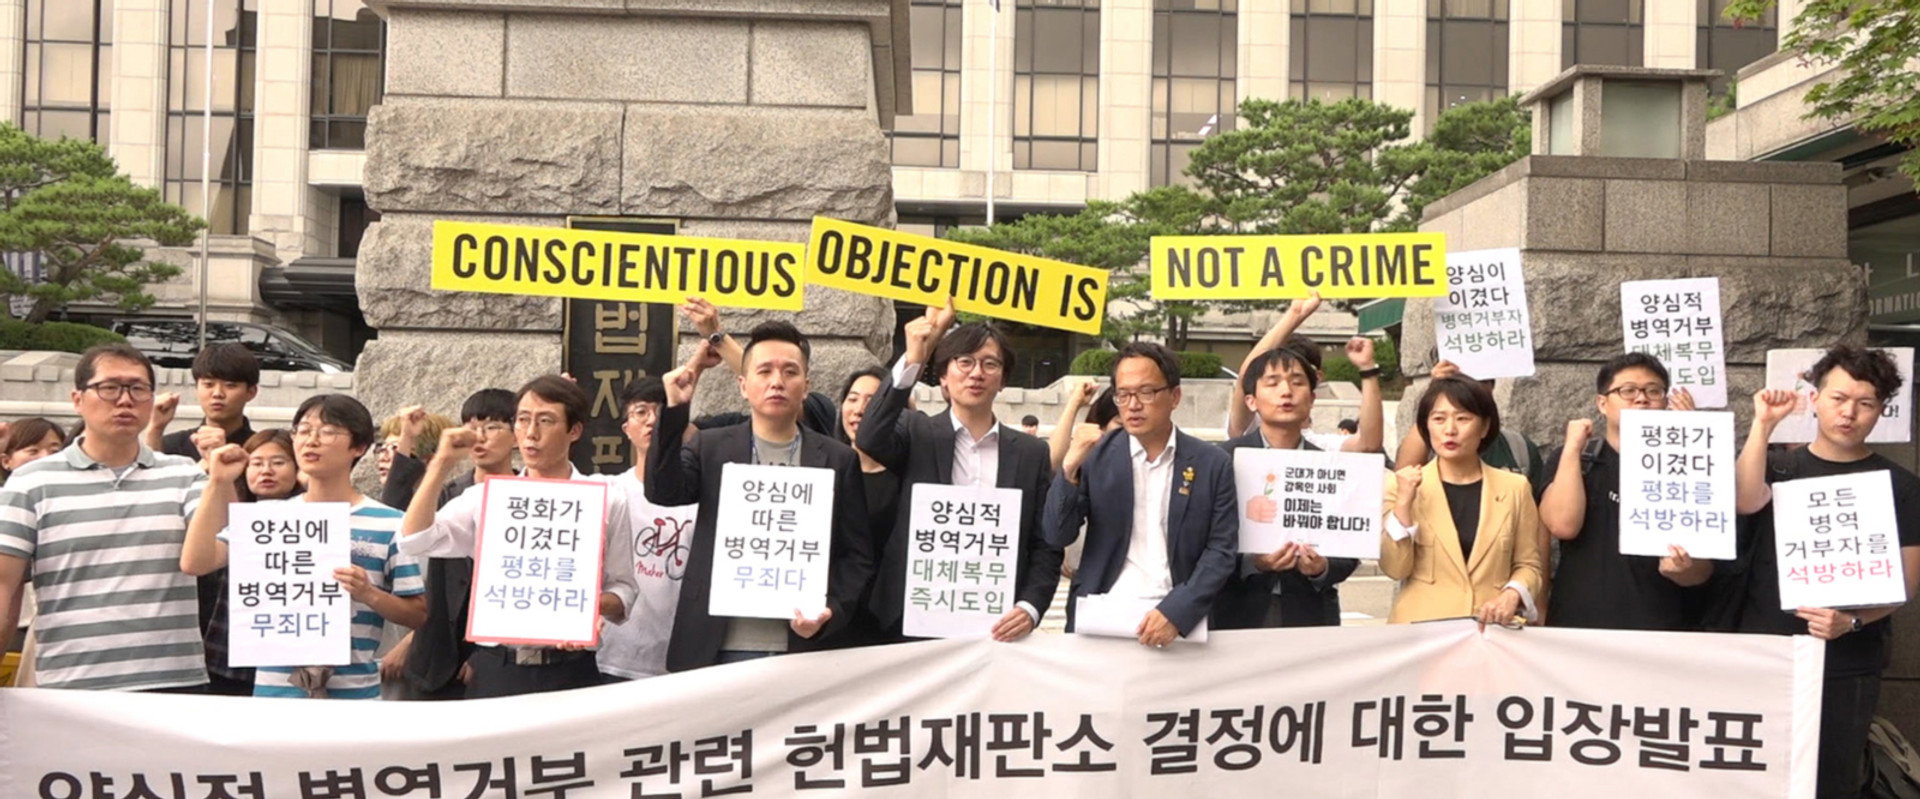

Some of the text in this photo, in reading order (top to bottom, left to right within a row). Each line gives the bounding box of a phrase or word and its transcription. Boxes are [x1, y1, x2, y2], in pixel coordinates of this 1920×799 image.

[453, 233, 796, 298] CONSCIENTIOUS
[817, 230, 1099, 321] OBJECTION IS
[1167, 244, 1435, 288] NOT A CRIME
[1446, 262, 1505, 285] 양심이
[1449, 286, 1509, 308] 이겼다
[1640, 292, 1702, 314] 양심적
[1441, 309, 1522, 330] 병역거부자
[1630, 317, 1713, 339] 병역거부
[1444, 329, 1526, 353] 석방하라
[1668, 366, 1716, 385] 도입
[1641, 425, 1714, 449] 평화가
[1285, 467, 1346, 481] 군대가 아니면
[1641, 452, 1715, 476] 이겼다
[743, 480, 813, 505] 양심에
[1317, 483, 1337, 494] 사회
[1641, 480, 1714, 505] 평화를
[1808, 488, 1856, 508] 모든
[507, 497, 582, 523] 평화가
[931, 500, 1000, 527] 양심적
[1284, 498, 1323, 514] 이제는
[251, 520, 328, 544] 양심에
[752, 509, 797, 532] 따른
[1283, 514, 1370, 532] 바꿔야 합니다!
[1629, 508, 1728, 533] 석방하라
[1810, 511, 1858, 534] 병역
[504, 526, 579, 551] 이겼다
[724, 536, 820, 562] 병역거부
[915, 530, 1009, 556] 병역거부
[1785, 533, 1889, 559] 거부자를
[265, 551, 315, 575] 따른
[501, 555, 577, 582] 평화를
[913, 559, 1007, 585] 대체복무
[1787, 559, 1893, 585] 석방하라
[734, 566, 807, 591] 무죄다
[238, 582, 342, 607] 병역거부
[484, 585, 588, 612] 석방하라
[910, 587, 1004, 614] 즉시도입
[251, 612, 330, 637] 무죄다
[620, 729, 753, 799] 관련
[784, 712, 1117, 790] 헌법재판소
[1142, 701, 1326, 775] 결정에
[1350, 694, 1474, 760] 대한
[1496, 696, 1767, 772] 입장발표
